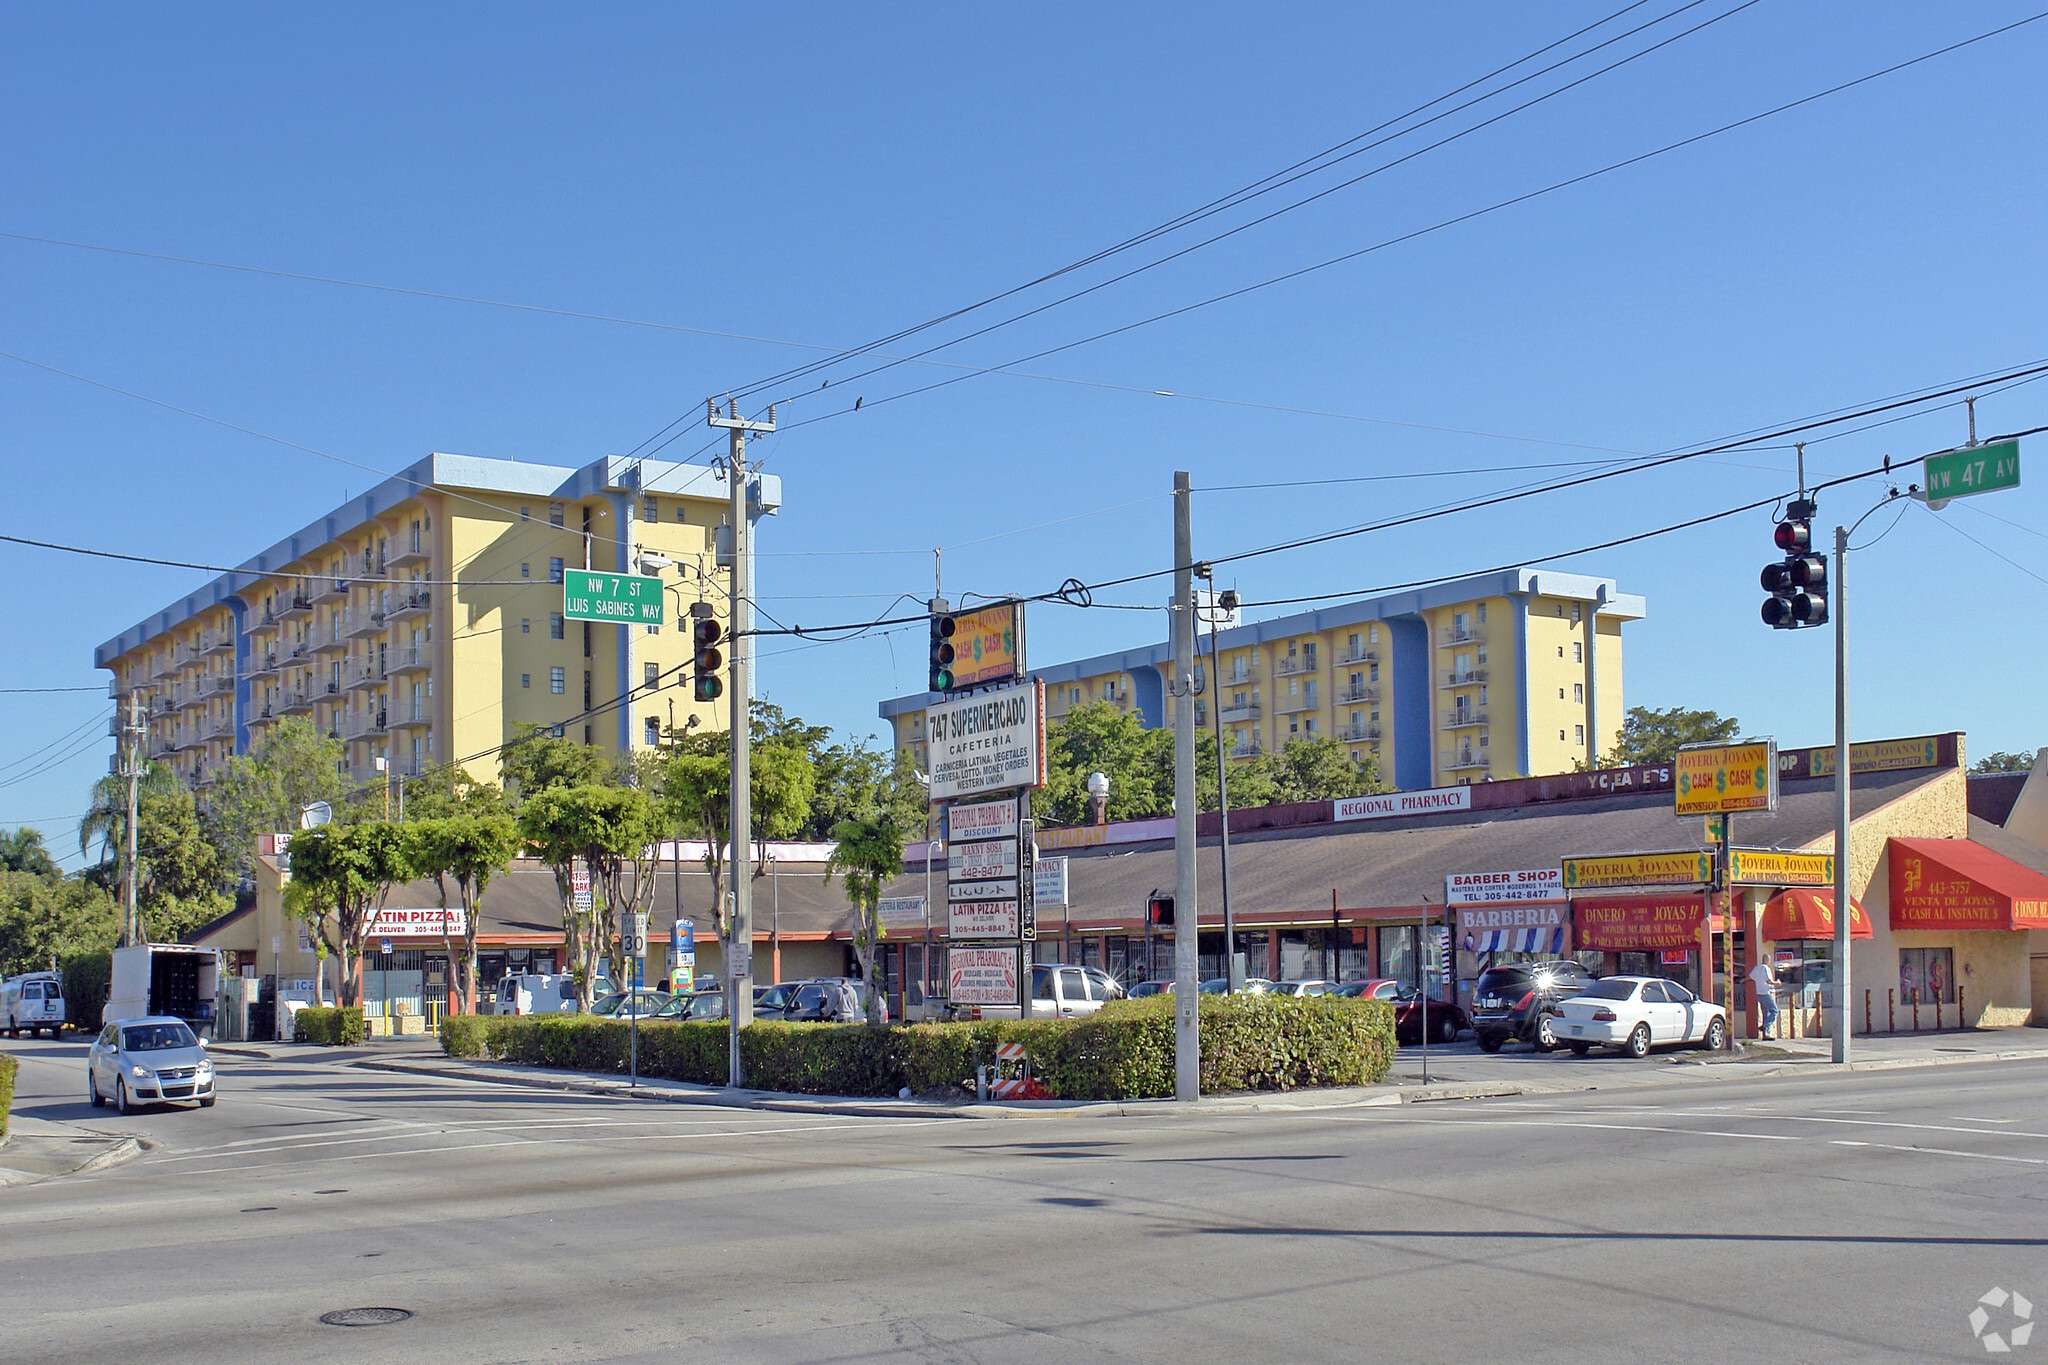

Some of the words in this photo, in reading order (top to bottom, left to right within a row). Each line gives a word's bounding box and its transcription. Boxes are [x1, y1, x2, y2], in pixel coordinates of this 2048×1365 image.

[1930, 471, 1950, 490] NW
[1962, 461, 1985, 486] 47
[1996, 457, 2014, 478] AV
[588, 578, 603, 593] NW
[612, 579, 620, 597] 7
[630, 582, 641, 596] ST
[568, 597, 588, 612] LUIS
[596, 600, 635, 617] SABINES
[642, 604, 660, 619] WAY
[956, 640, 971, 660] CASH
[985, 633, 1000, 653] CASH
[930, 713, 947, 743] 747
[951, 696, 1026, 738] SUPERMERCADO
[950, 734, 1011, 755] CAFETERIA
[1874, 743, 1921, 757] JOVANNI
[935, 759, 967, 773] CARNICERIA
[993, 747, 1027, 762] VEGETALES
[983, 763, 1004, 776] MONEY
[1005, 758, 1029, 772] ORDERS
[1679, 753, 1719, 769] JOYERIA
[1722, 749, 1764, 765] JOVANNI
[957, 777, 984, 790] WESTERN
[985, 773, 1005, 785] UNION
[1692, 772, 1713, 789] CASH
[1729, 770, 1751, 787] CASH
[1341, 799, 1394, 816] REGIONAL
[1401, 792, 1462, 810] PHARMACY
[1677, 801, 1719, 813] PAWNSHOP
[952, 808, 976, 829] REGIONAL
[978, 805, 1006, 826] PHARMACY
[964, 826, 1001, 836] DISCOUNT
[961, 844, 984, 856] MANNY
[987, 842, 1002, 854] SOSA
[1579, 862, 1633, 877] JOYERIA
[1638, 859, 1694, 874] JOVANNI
[1741, 854, 1781, 871] JOYERIA
[1784, 856, 1823, 872] JOVANNI
[961, 865, 1003, 878] 442-8477
[1454, 874, 1511, 885] BARBER
[1517, 871, 1558, 882] SHOP
[1742, 871, 1756, 881] CASA
[1757, 872, 1765, 881] DE
[1580, 878, 1598, 886] CASA
[1600, 877, 1610, 886] DE
[1611, 874, 1641, 885] EMPEÑO
[1928, 881, 1971, 895] 443-5757
[1464, 893, 1481, 901] TEL:
[1485, 890, 1548, 900] 305-442-8477
[1905, 897, 1940, 906] VENTA
[1944, 897, 1959, 906] DE
[1963, 896, 1995, 906] JOYAS
[897, 900, 919, 910] RESTAURANT
[953, 904, 975, 916] LATIN
[977, 902, 1000, 914] PIZZA
[2020, 901, 2038, 918] DONDE
[411, 911, 455, 923] PIZZA
[1463, 908, 1559, 928] BARBERIA
[1585, 908, 1626, 923] DINERO
[1654, 905, 1686, 921] JOYAS
[1909, 908, 1931, 920] CASH
[1934, 908, 1945, 920] AL
[1948, 908, 1990, 920] INSTANTE
[954, 925, 1006, 933] 305-445-8847
[1602, 925, 1626, 934] DONDE
[1653, 924, 1662, 933] SE
[1664, 923, 1683, 932] PAGA
[624, 935, 643, 951] 30
[1594, 937, 1611, 947] ORO
[1644, 934, 1691, 947] DIAMANTES
[951, 951, 975, 971] REGIONAL
[977, 950, 1007, 968] PHARMACY
[296, 981, 315, 990] ICE
